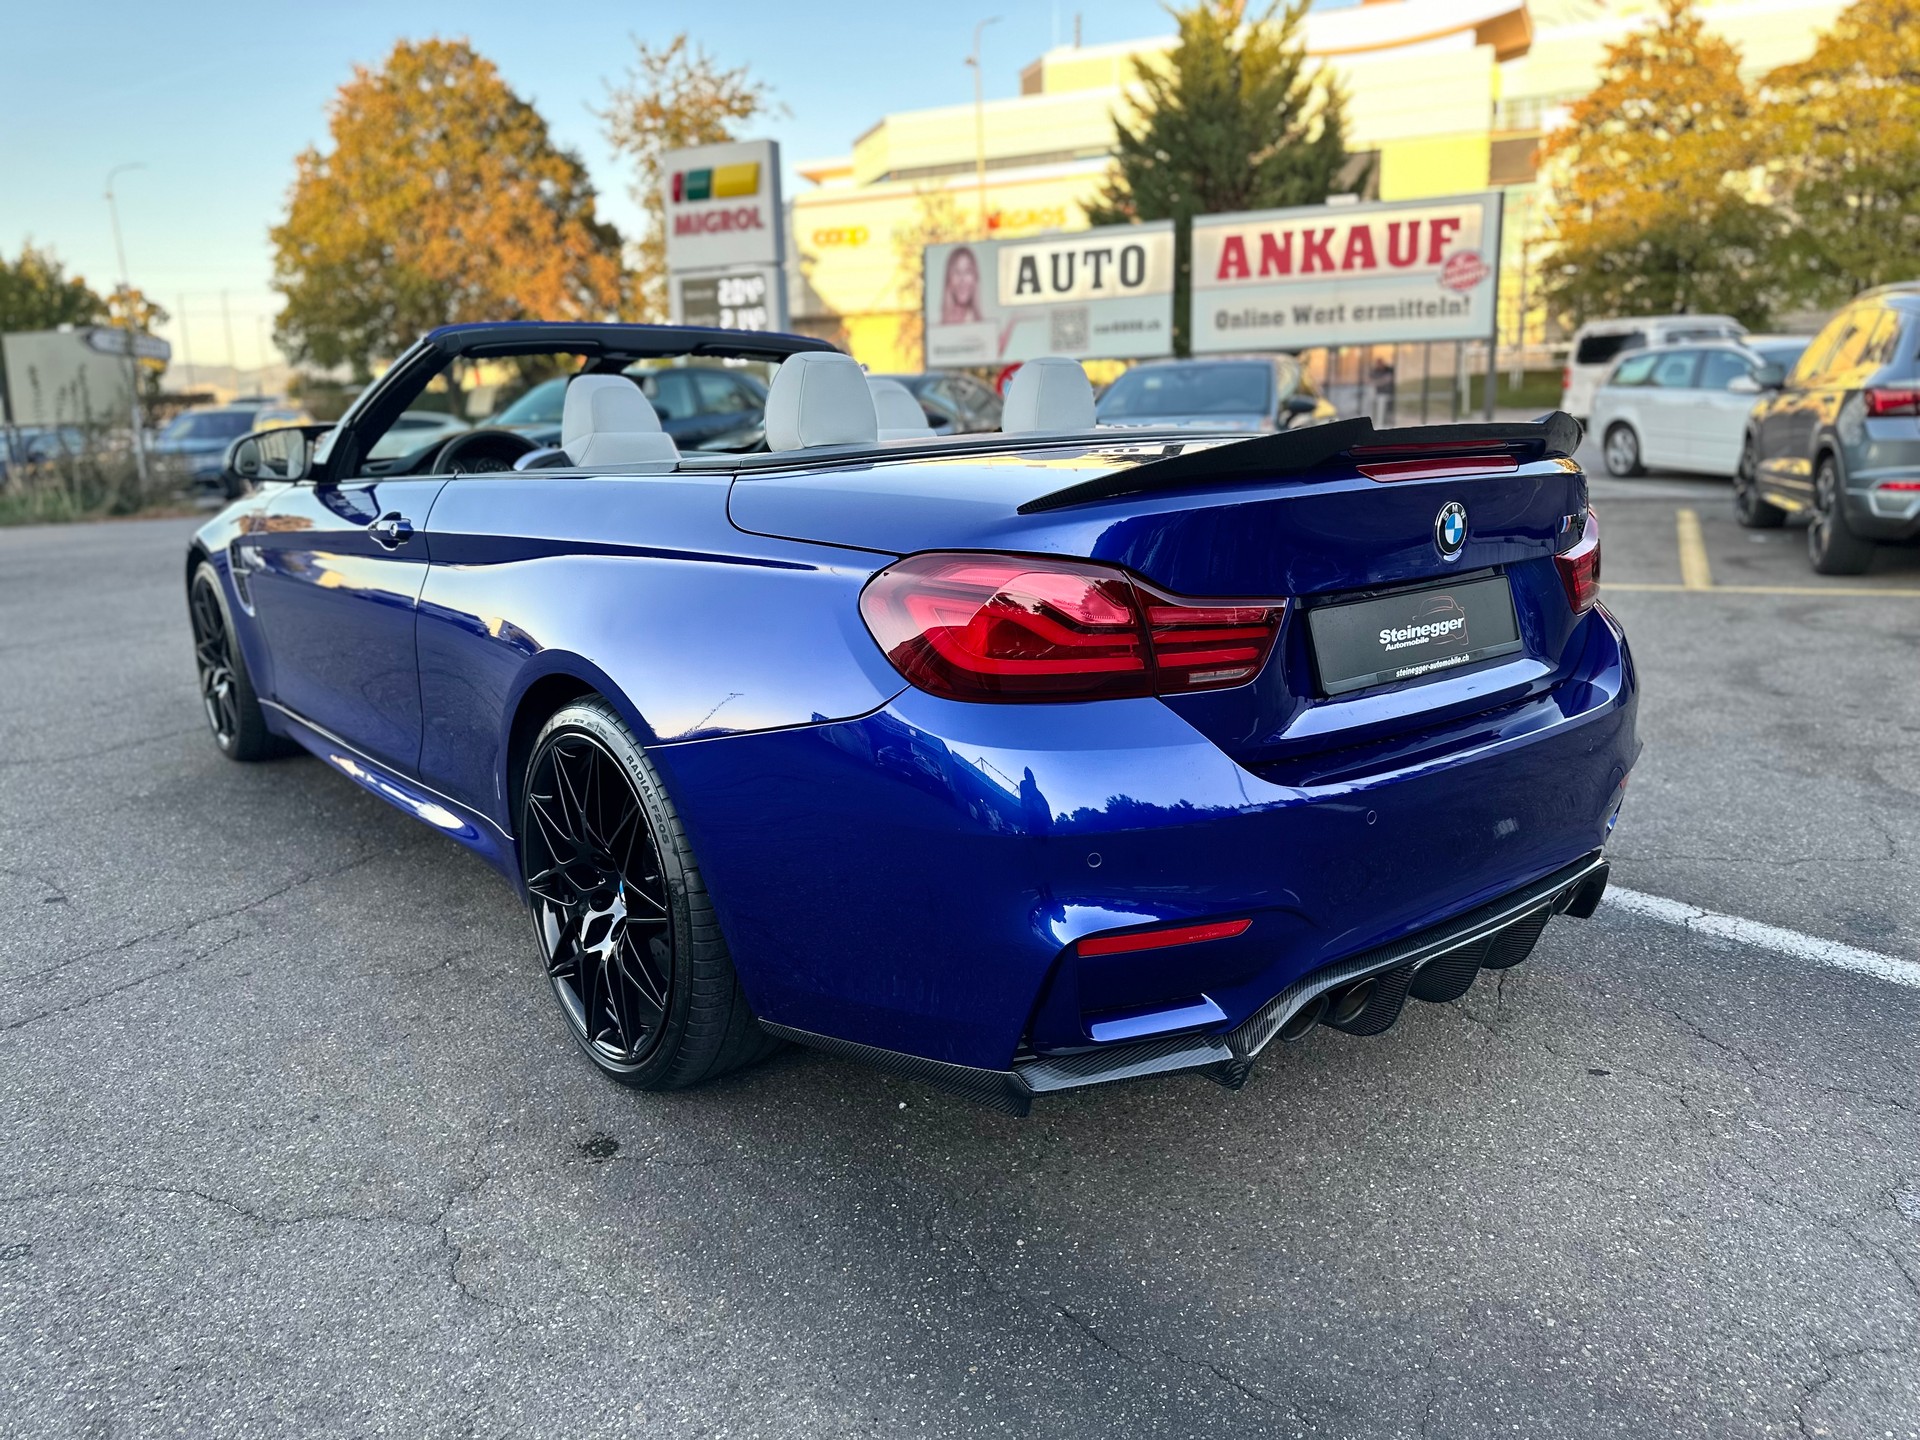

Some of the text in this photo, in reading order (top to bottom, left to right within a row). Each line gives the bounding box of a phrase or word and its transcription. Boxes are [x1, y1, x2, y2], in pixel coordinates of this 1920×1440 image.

[674, 206, 764, 235] MIGROL
[1217, 217, 1461, 280] ANKAUF
[1015, 245, 1146, 295] AUTO
[1215, 297, 1471, 330] Online Wert ermitteln!
[1442, 504, 1467, 521] BMW
[1379, 617, 1464, 644] Steinegger
[1385, 636, 1430, 652] Automobile
[1396, 653, 1470, 678] steinegger-automobile.ch
[626, 754, 654, 802] RADIAL
